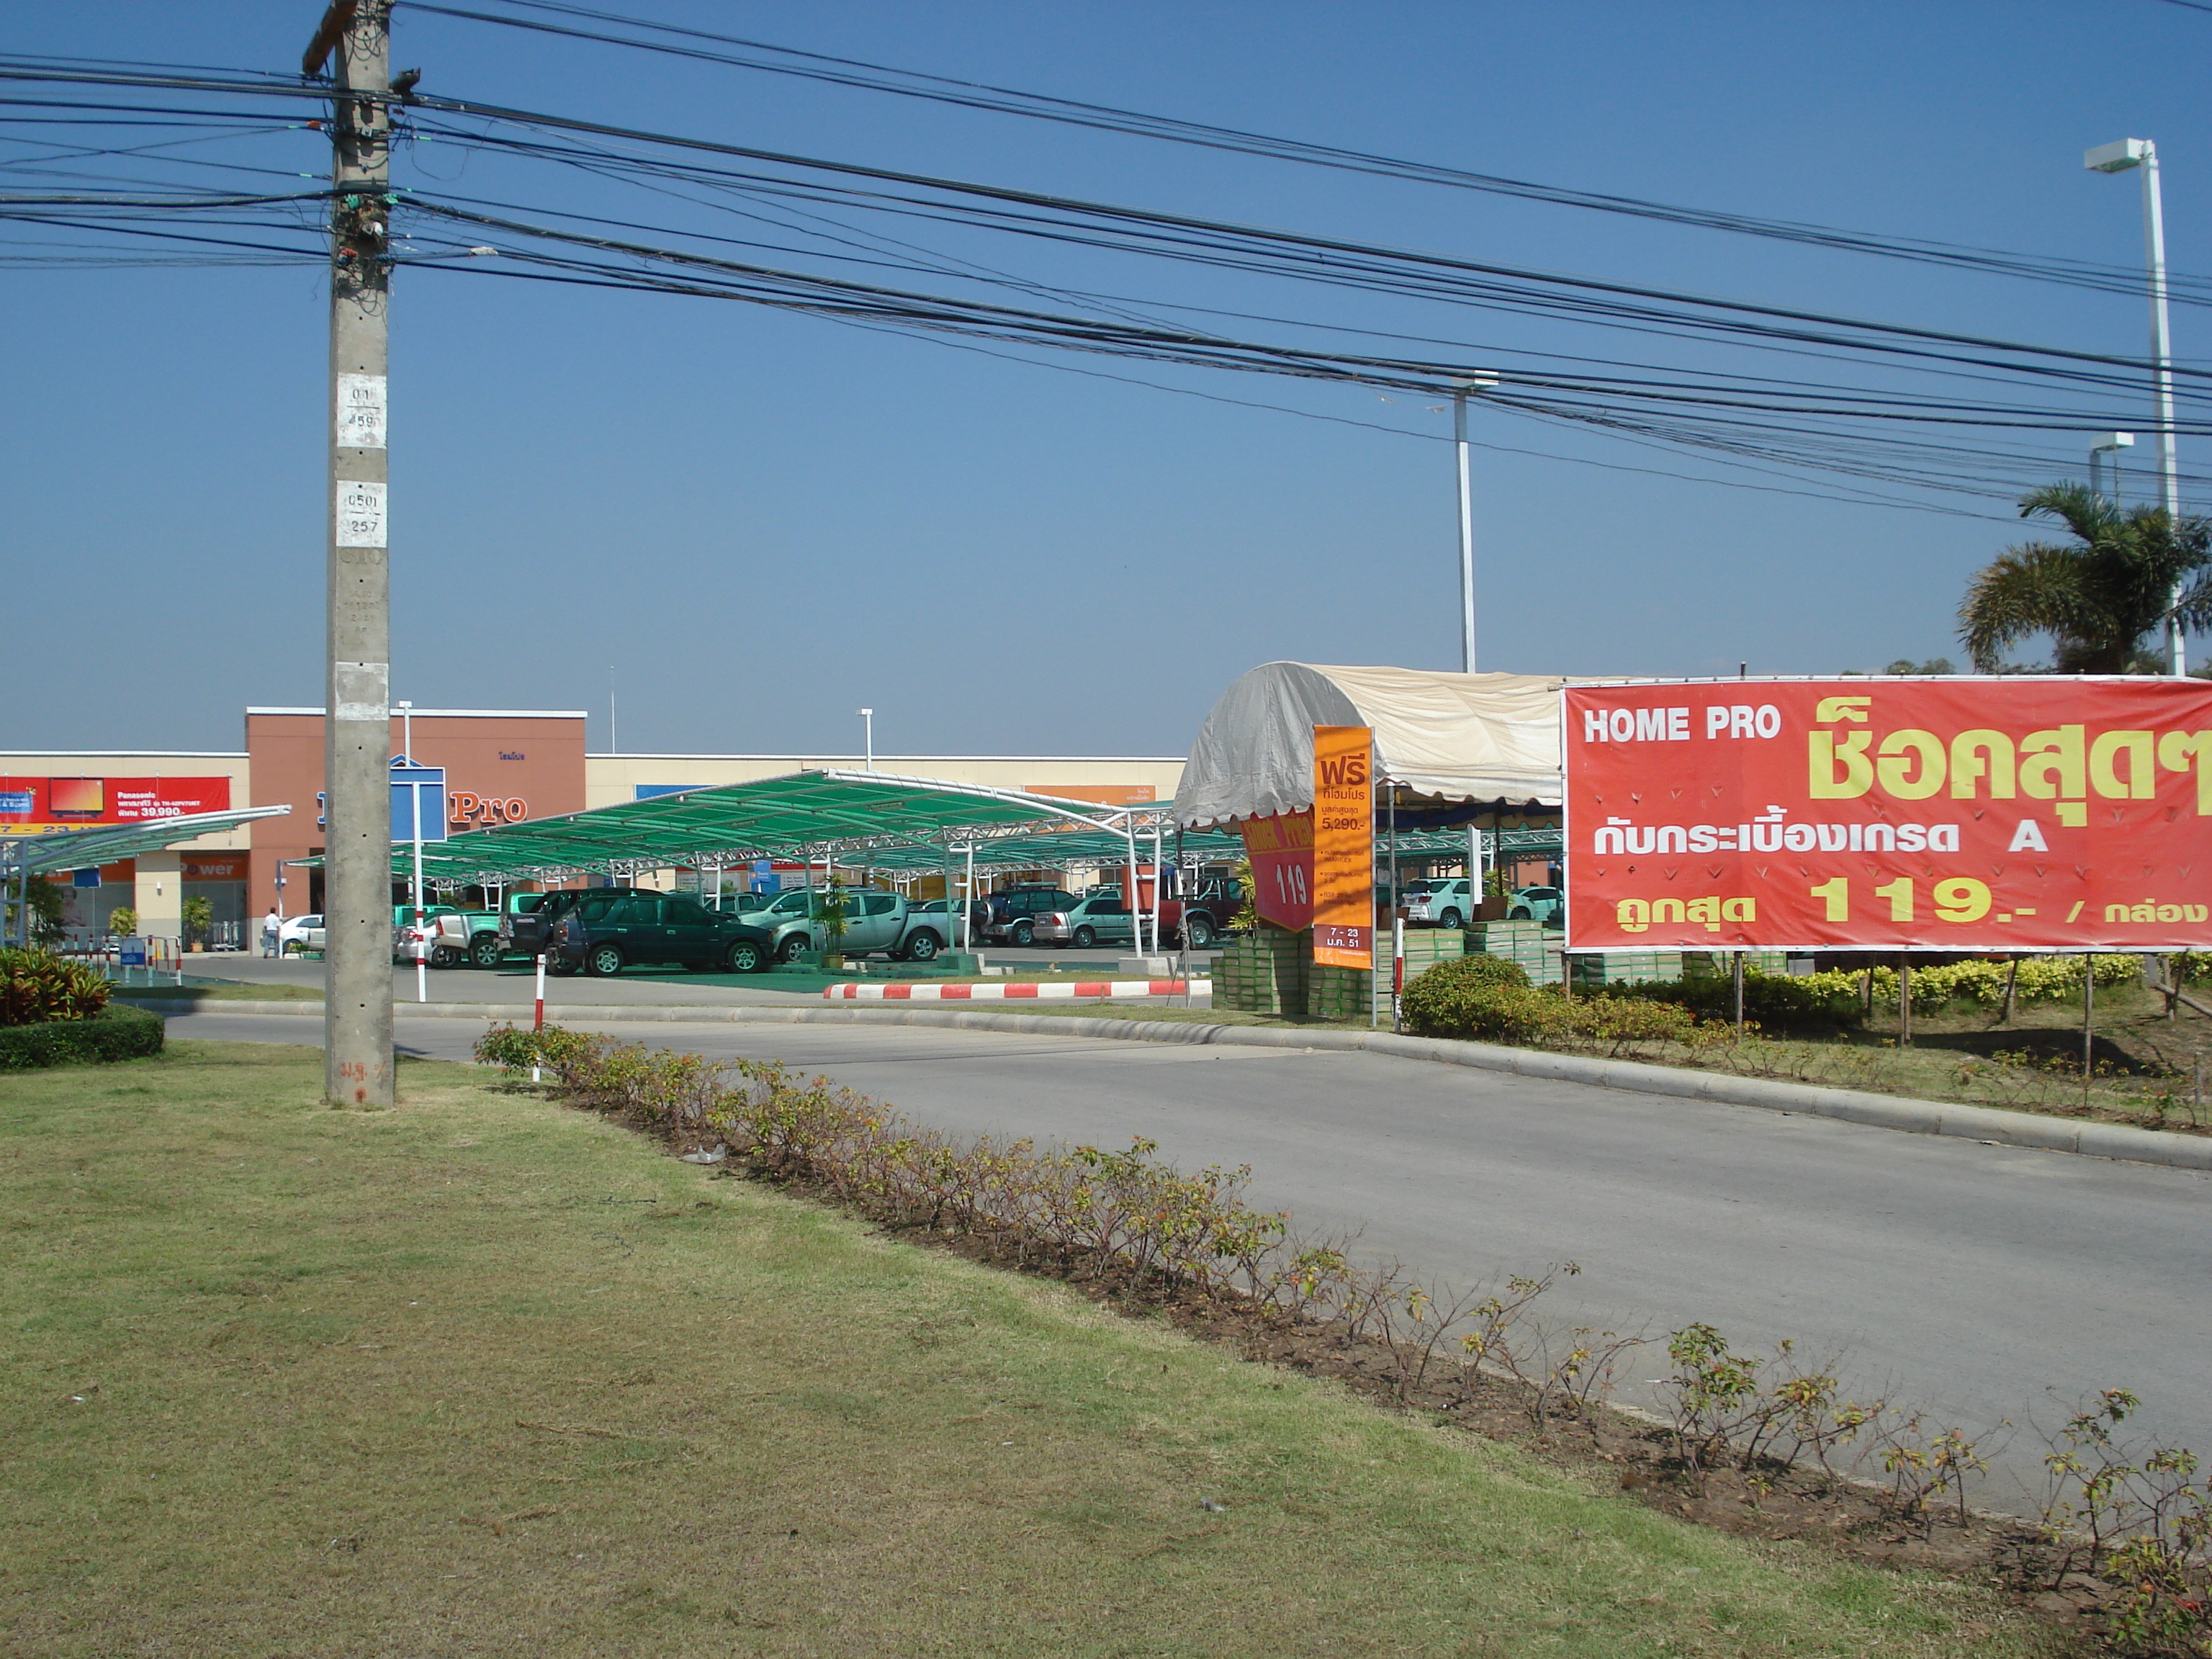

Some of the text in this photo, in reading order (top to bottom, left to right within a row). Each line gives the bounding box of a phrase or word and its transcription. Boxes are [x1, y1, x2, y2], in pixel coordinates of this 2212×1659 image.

[351, 520, 377, 532] 257
[1584, 703, 1781, 743] HOME PRO
[1320, 752, 1365, 786] ฟรี
[117, 791, 156, 799] Panasonic
[1323, 785, 1365, 801] ที่โฮมโปร
[449, 791, 528, 823] Pro
[1321, 804, 1359, 816] มูลค่าสูงสุด
[1322, 817, 1366, 832] 5,290.-
[1593, 804, 2049, 855] กับกระเบื้องเกรด A
[1276, 864, 1308, 905] 119
[1617, 896, 1756, 932] ถูกสุด
[2105, 898, 2209, 923] กล่อง
[1331, 927, 1337, 936] 7
[1347, 928, 1359, 938] 23
[1326, 938, 1359, 948] ม.ค. 51
